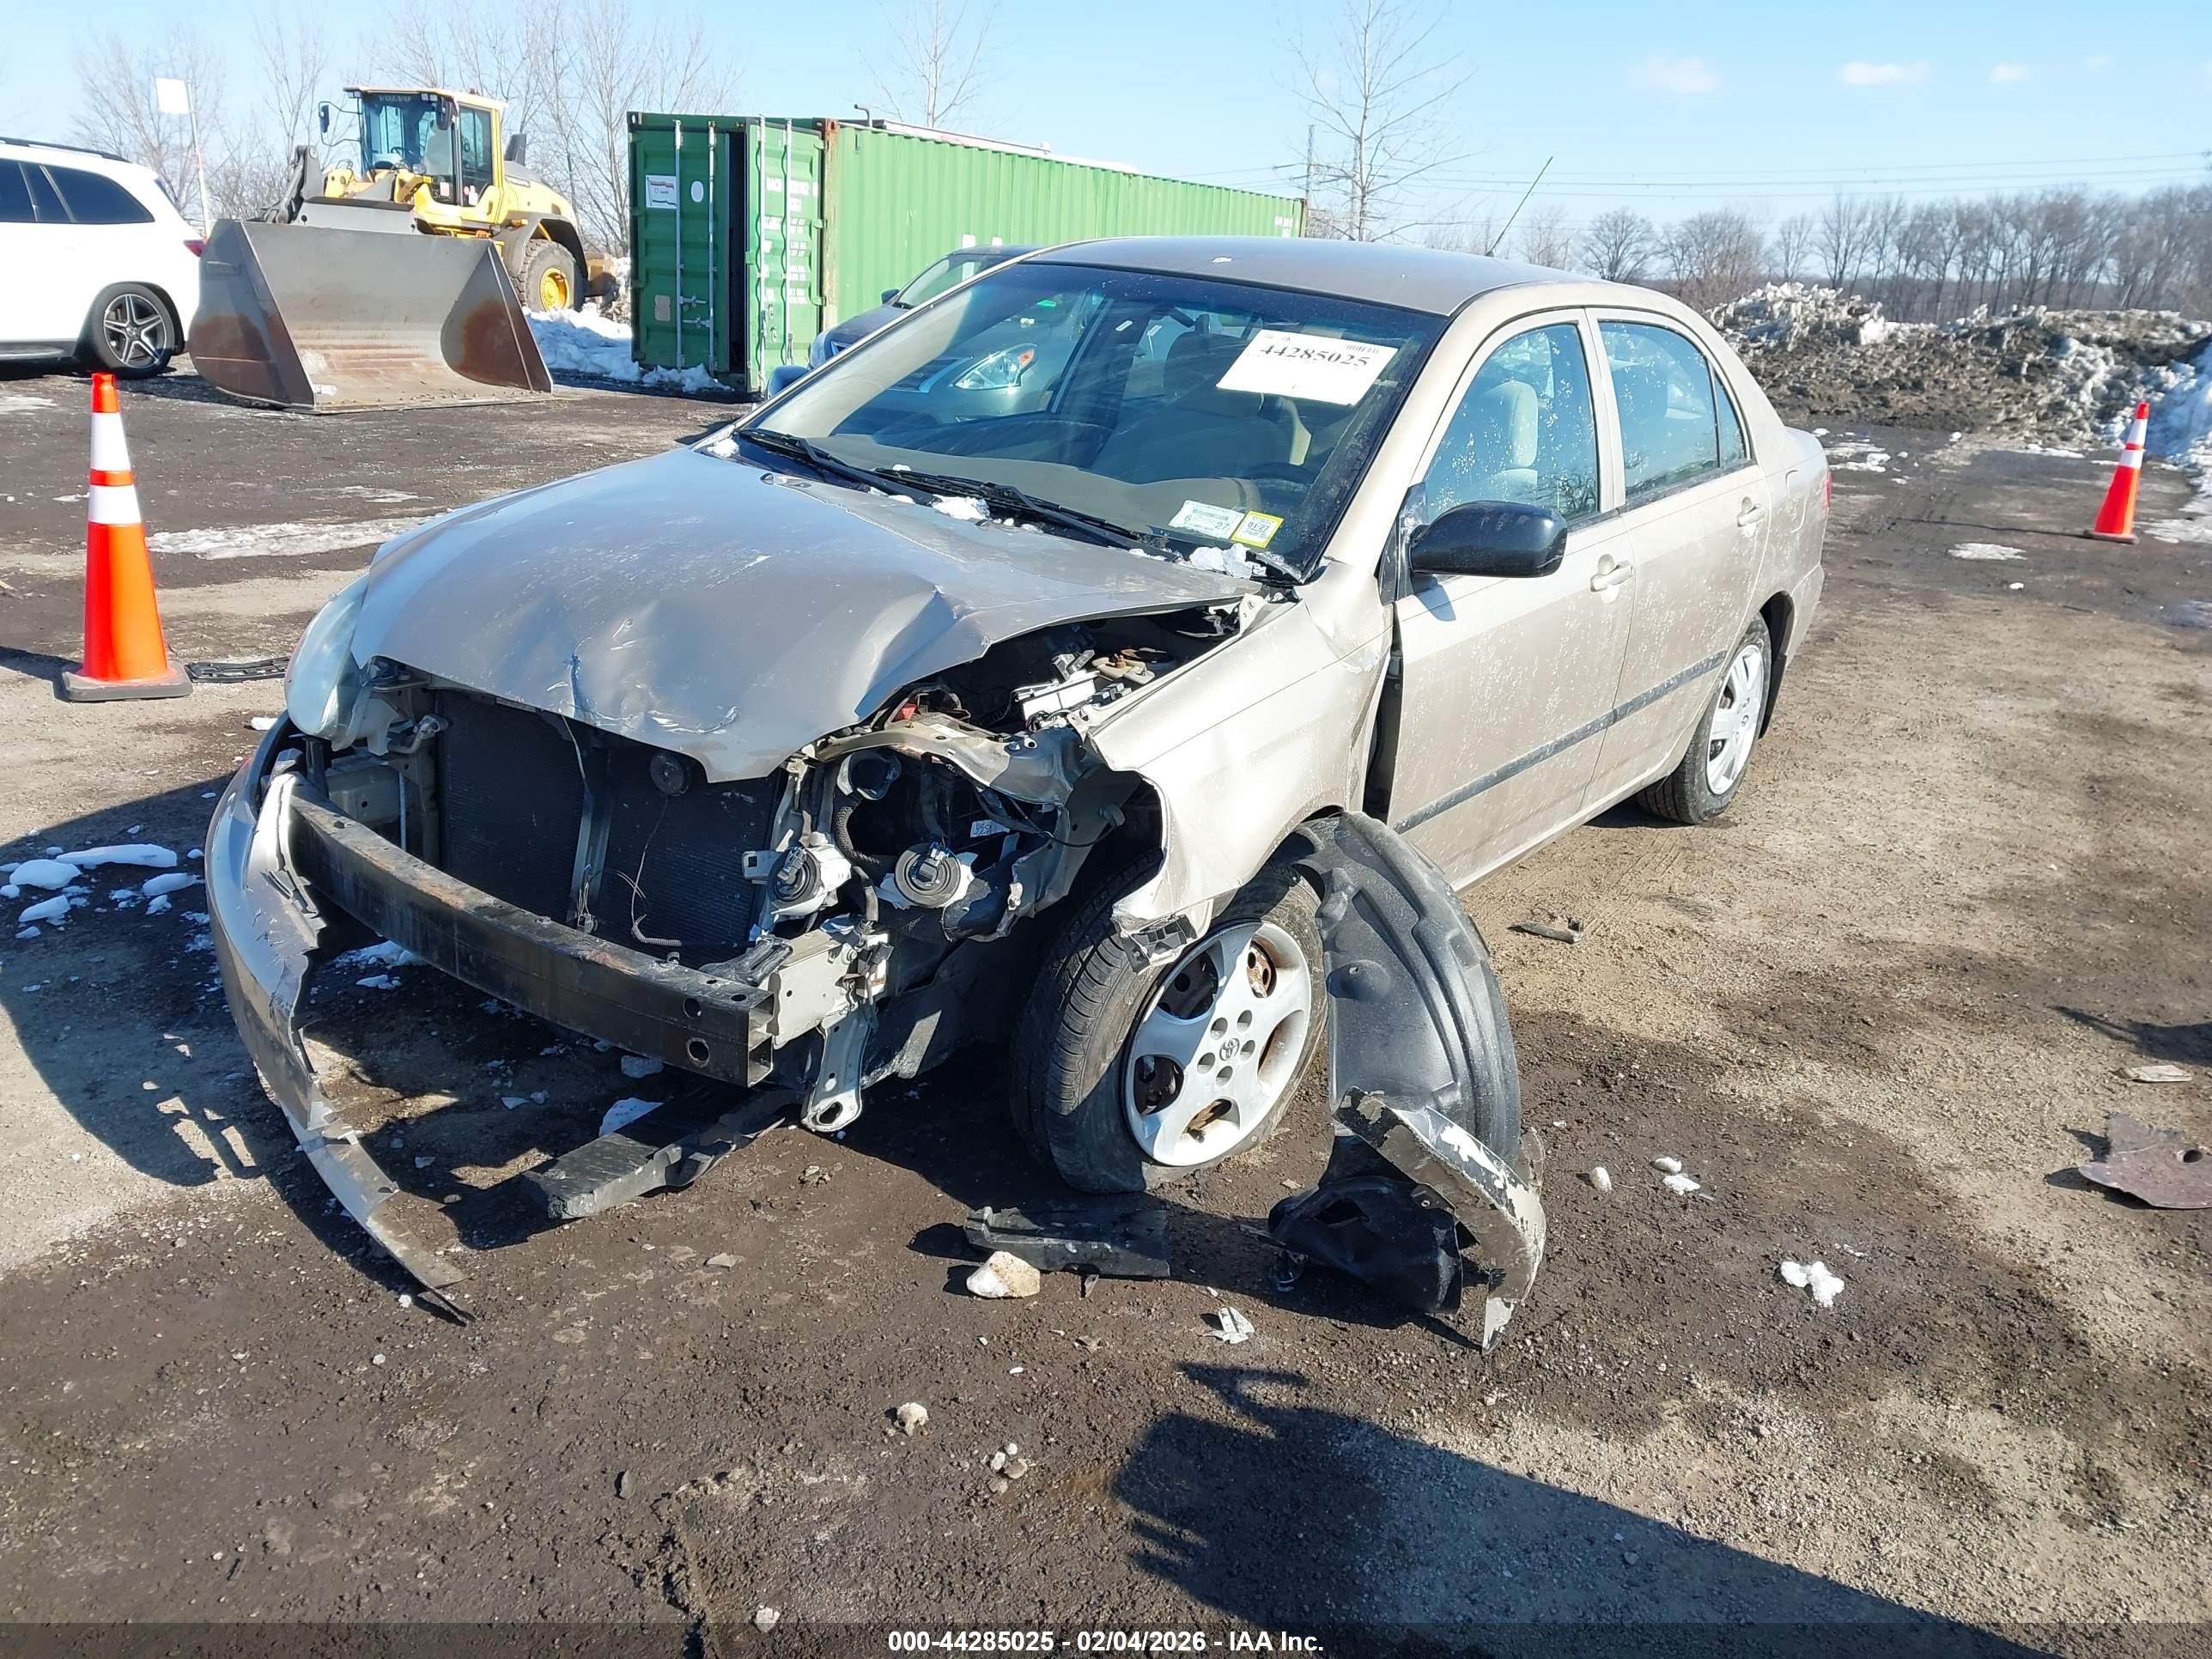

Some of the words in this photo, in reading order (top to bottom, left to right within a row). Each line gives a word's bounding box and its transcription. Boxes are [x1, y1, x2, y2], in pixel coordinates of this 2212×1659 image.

[1260, 343, 1371, 368] 44285025
[1215, 521, 1231, 531] 27
[1247, 521, 1271, 532] 01-27
